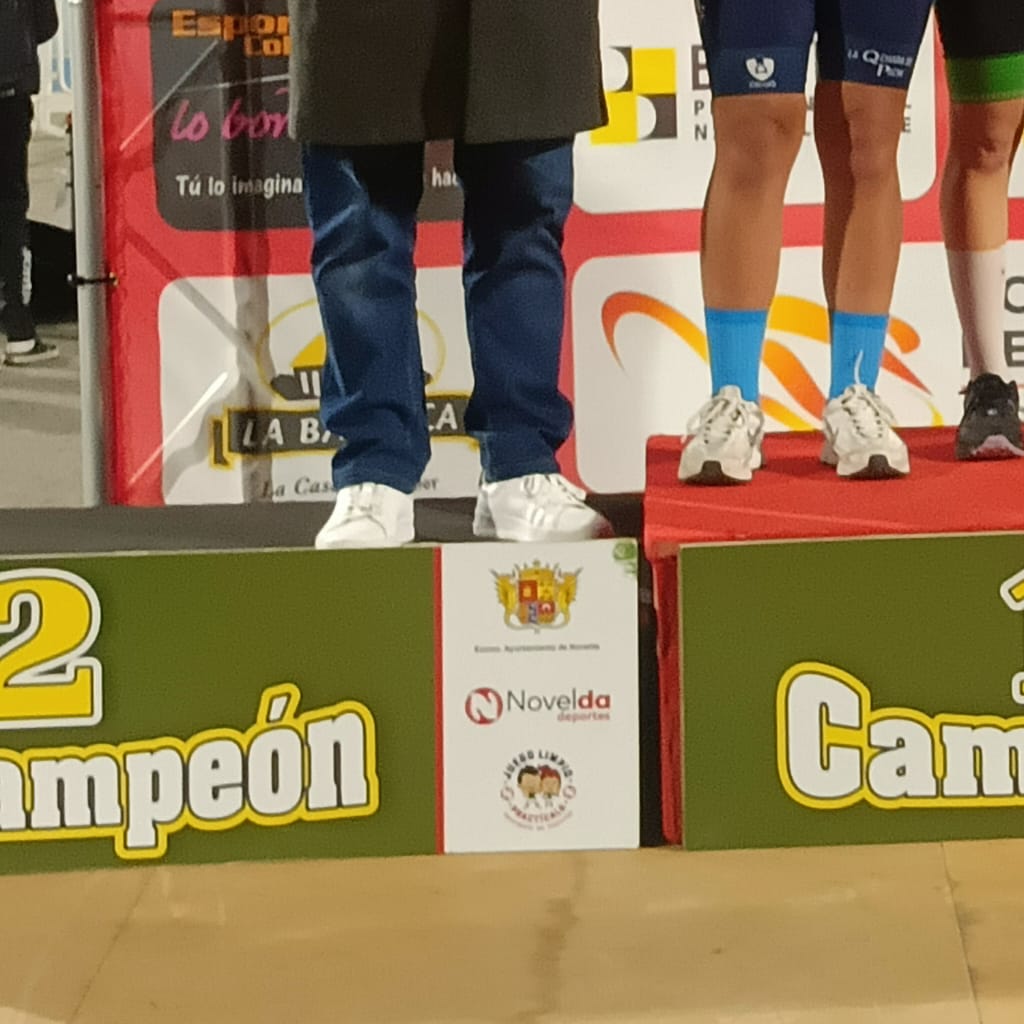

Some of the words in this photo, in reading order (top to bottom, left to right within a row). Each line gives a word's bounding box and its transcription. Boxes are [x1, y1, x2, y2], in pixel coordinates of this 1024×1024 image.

[175, 174, 201, 197] Tú
[208, 176, 226, 197] lo
[231, 174, 303, 200] imagina
[242, 417, 285, 447] LA
[293, 476, 334, 495] Cas
[0, 567, 103, 730] 2
[507, 687, 611, 713] Novelda
[0, 683, 380, 860] mpeón
